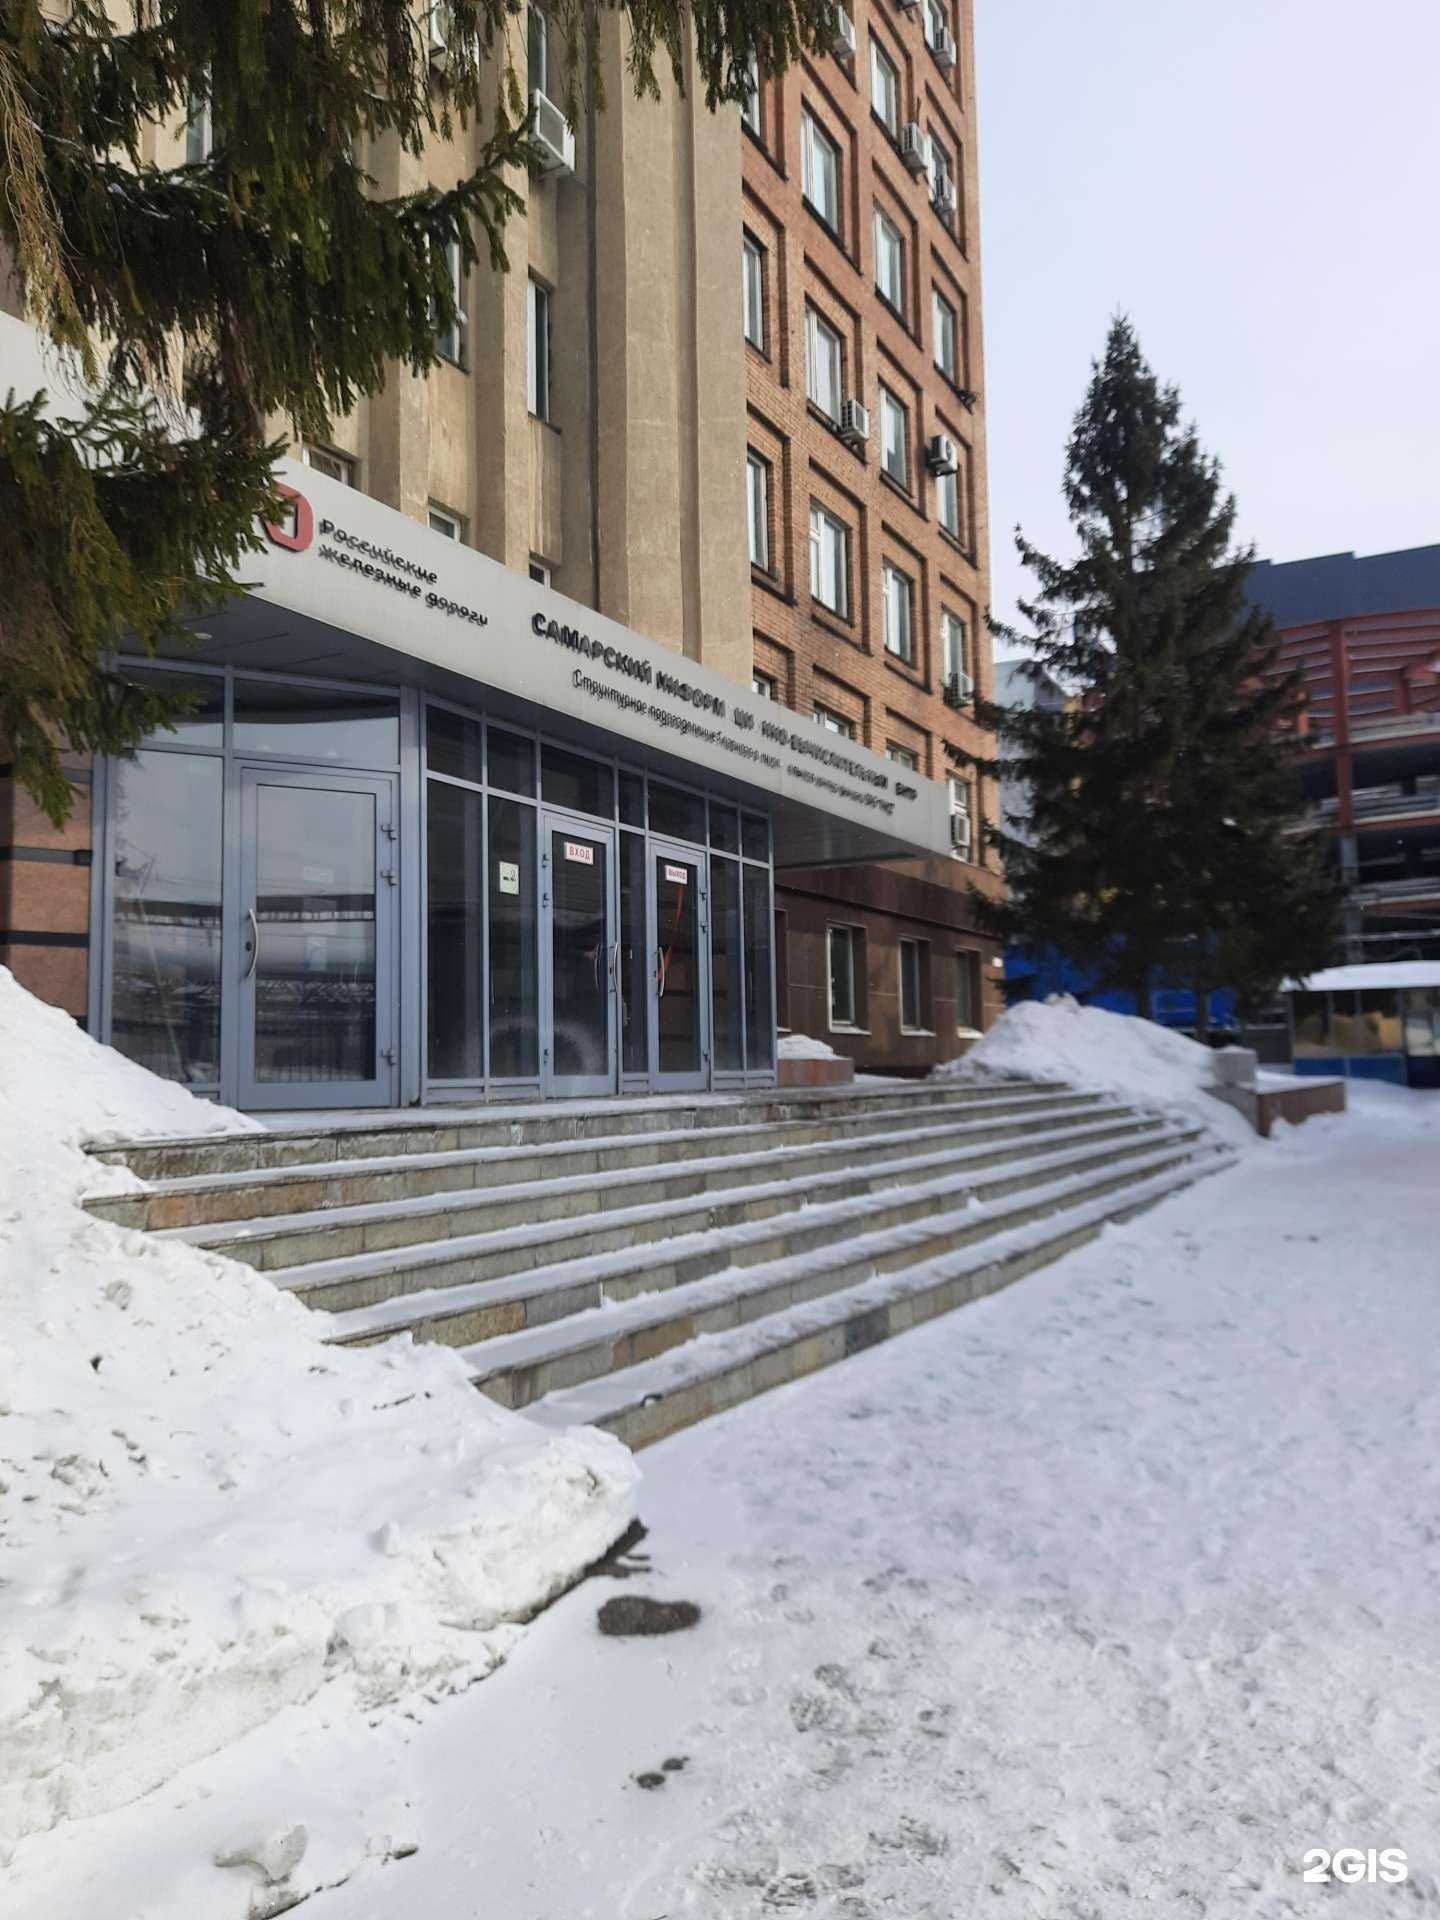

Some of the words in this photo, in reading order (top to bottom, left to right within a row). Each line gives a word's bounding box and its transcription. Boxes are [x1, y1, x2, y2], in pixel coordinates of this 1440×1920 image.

[318, 518, 438, 584] Российские
[425, 592, 488, 627] дороги
[531, 612, 652, 685] САМАРСКИЙ
[572, 668, 648, 711] Структурное
[569, 846, 591, 862] ВХОД
